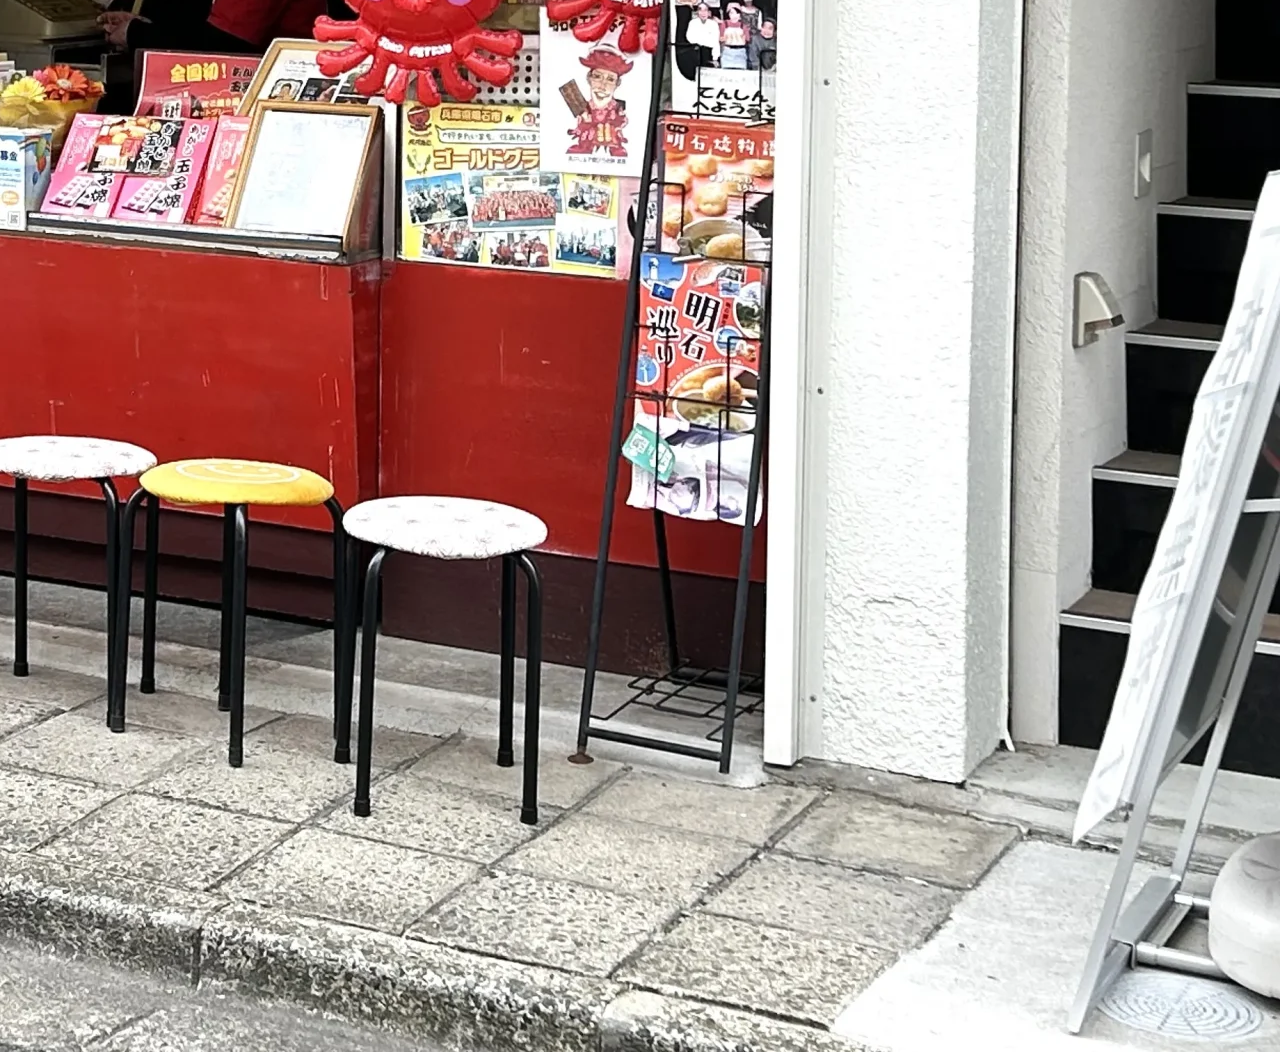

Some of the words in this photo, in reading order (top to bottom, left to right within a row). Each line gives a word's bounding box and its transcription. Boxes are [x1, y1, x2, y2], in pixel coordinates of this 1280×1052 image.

[698, 86, 768, 102] てんしん
[681, 292, 721, 361] 明石
